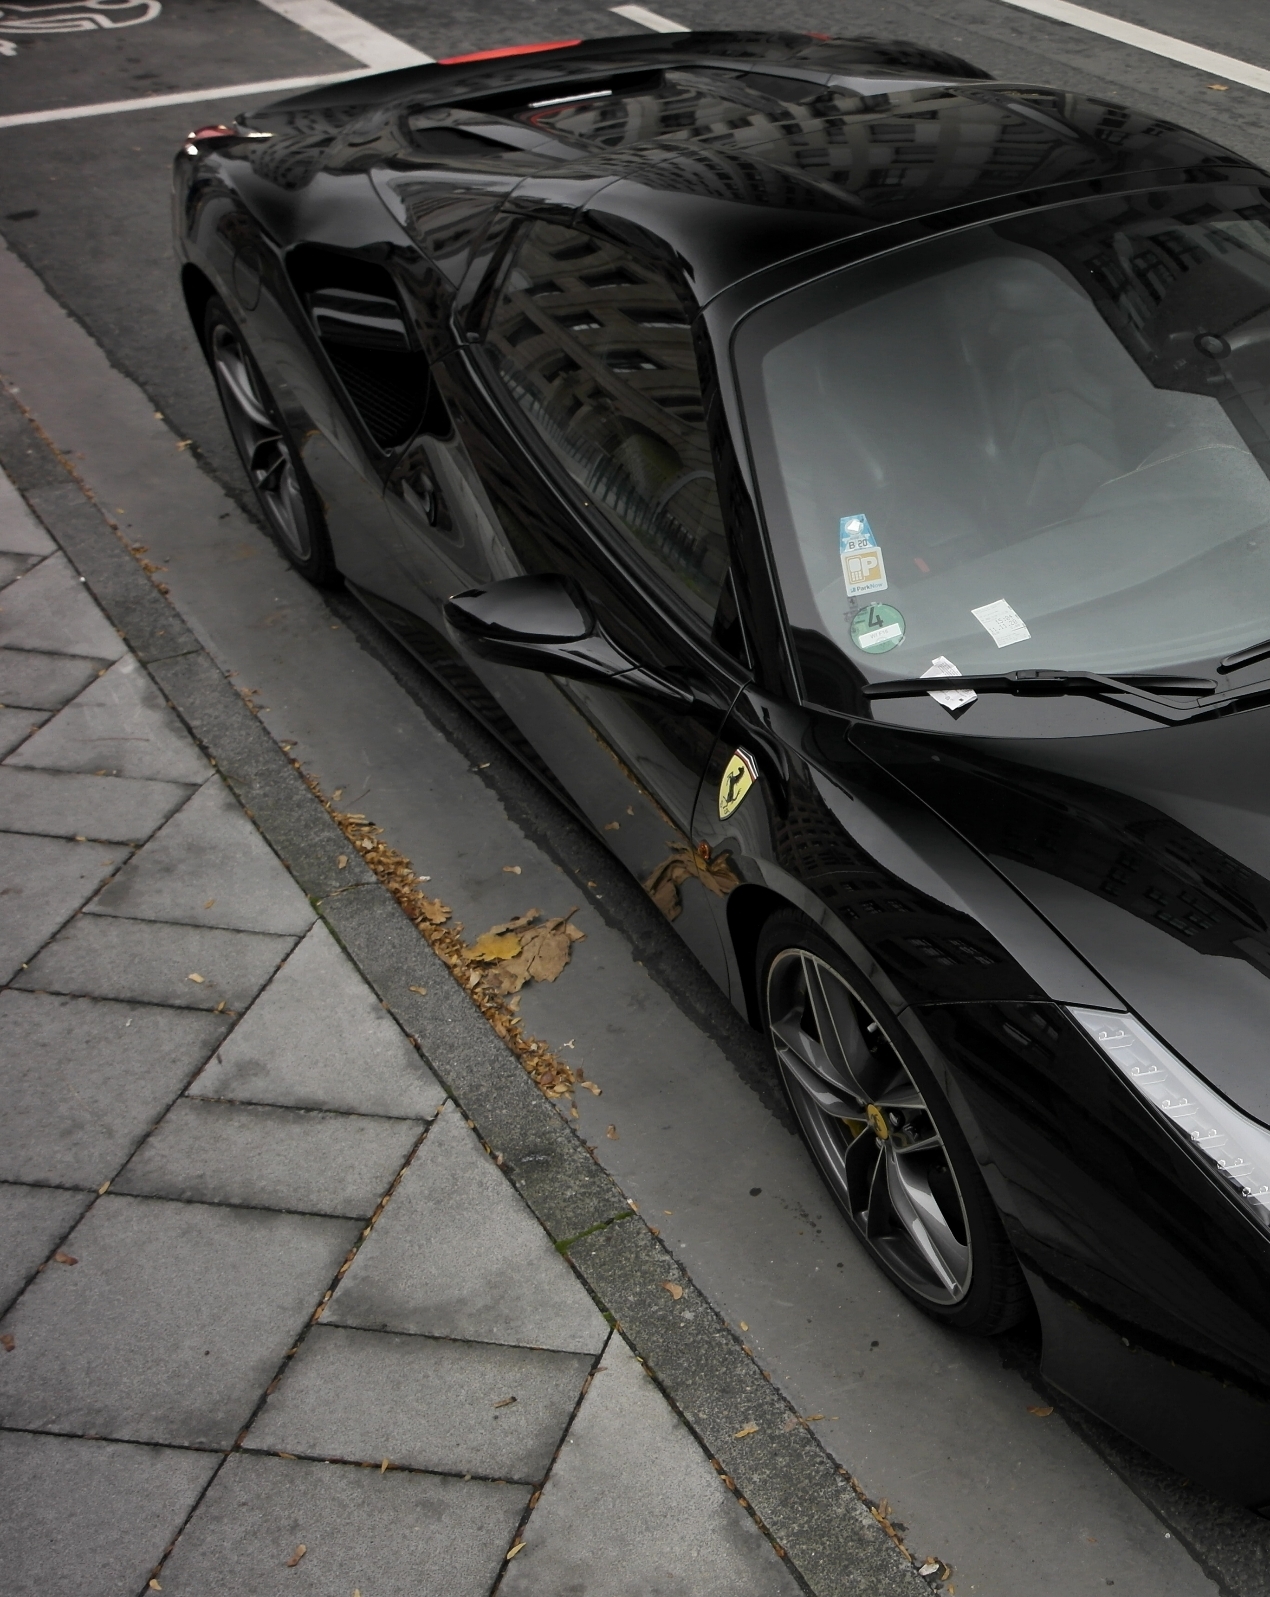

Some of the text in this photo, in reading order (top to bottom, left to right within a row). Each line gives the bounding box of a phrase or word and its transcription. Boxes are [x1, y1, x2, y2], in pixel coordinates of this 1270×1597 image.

[857, 539, 868, 548] 20
[861, 557, 878, 576] P
[856, 583, 882, 592] ParkNow
[868, 606, 884, 627] 4
